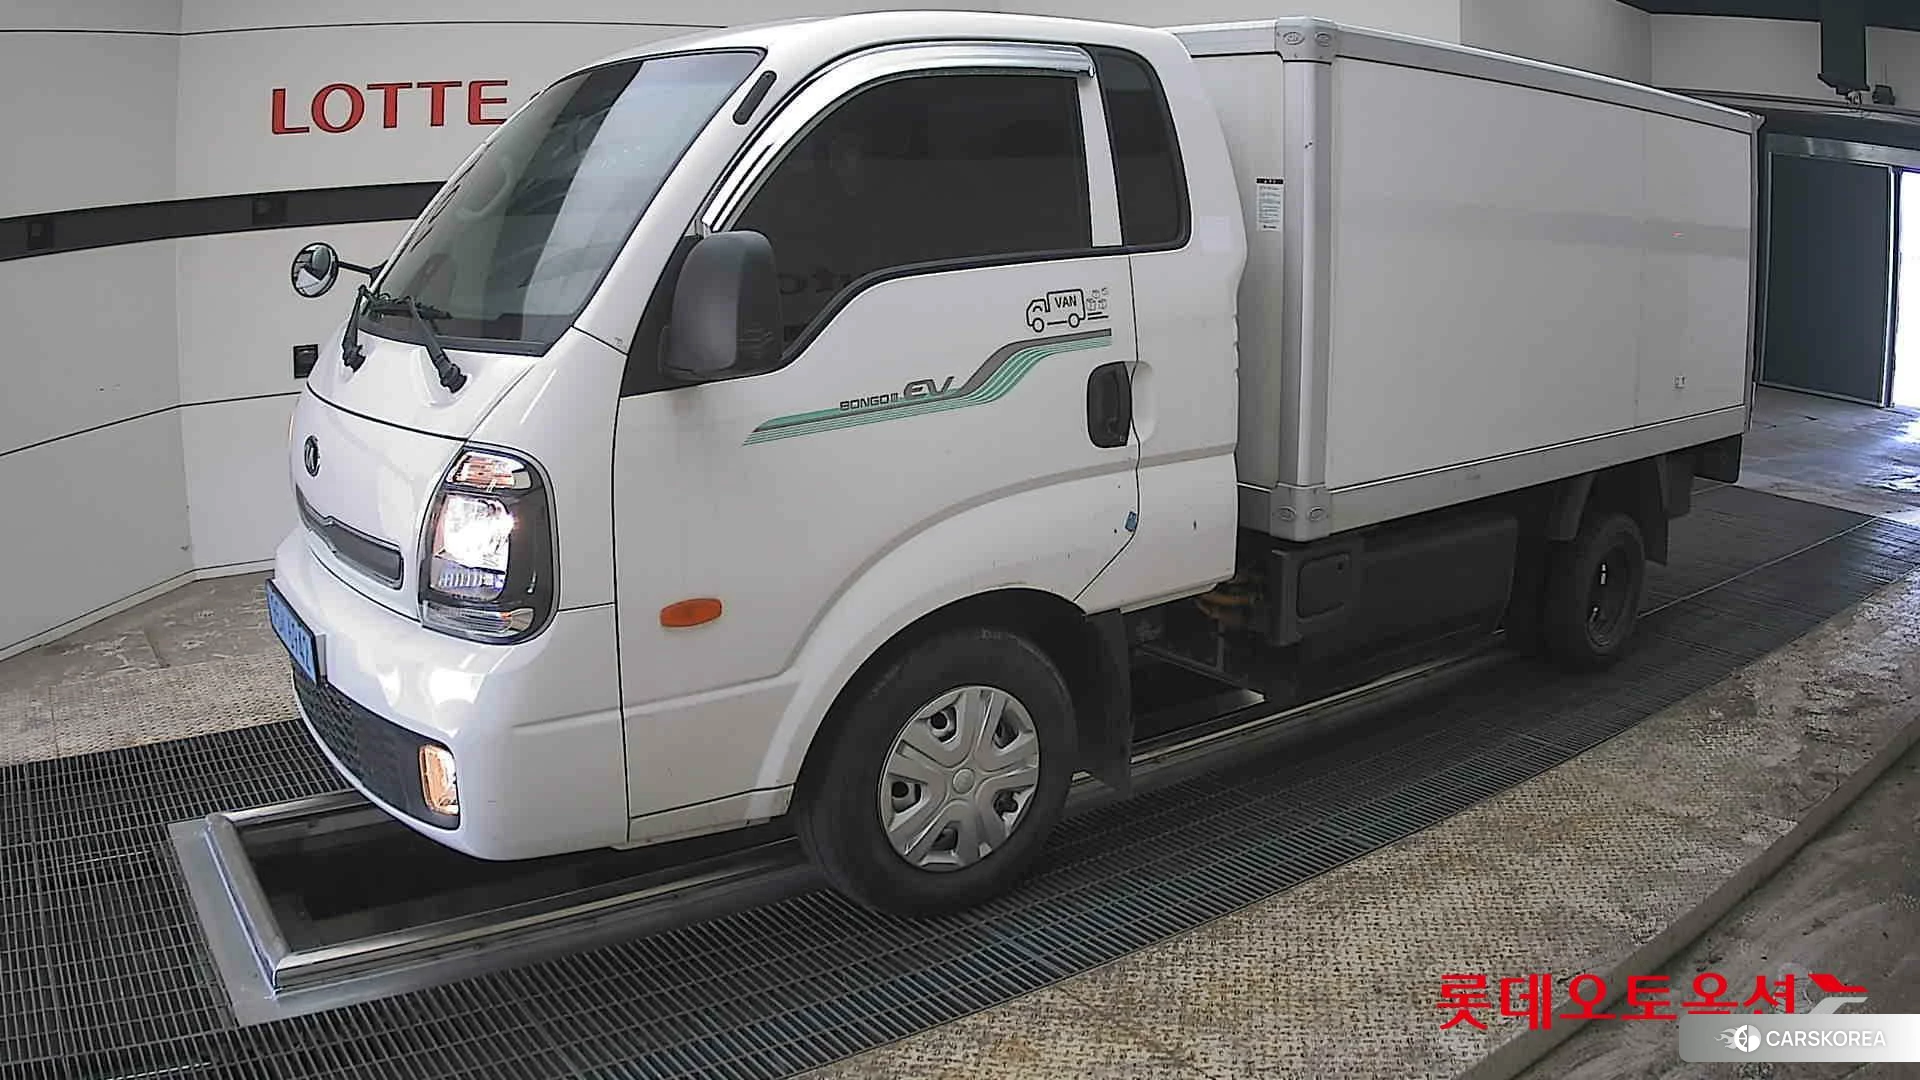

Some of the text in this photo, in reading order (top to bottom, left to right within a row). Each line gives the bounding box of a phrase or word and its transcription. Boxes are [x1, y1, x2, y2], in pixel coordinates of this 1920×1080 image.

[272, 80, 508, 135] LOTTE
[1054, 295, 1077, 308] VAN
[903, 376, 955, 400] EV
